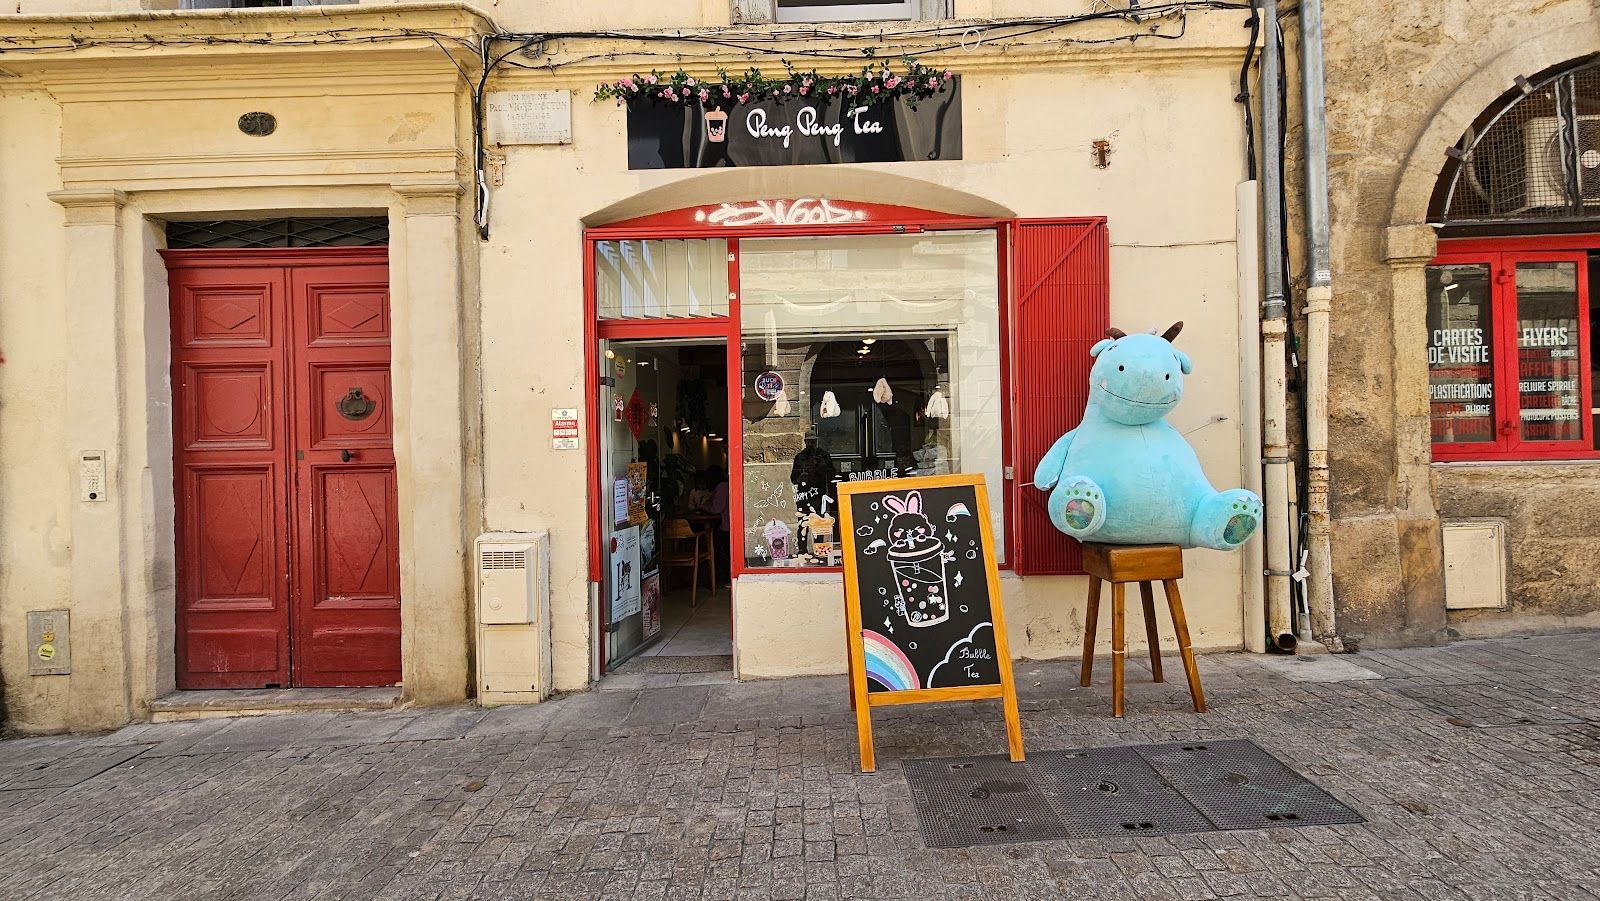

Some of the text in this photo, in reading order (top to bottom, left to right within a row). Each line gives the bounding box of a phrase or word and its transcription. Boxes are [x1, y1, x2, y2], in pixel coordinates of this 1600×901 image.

[746, 105, 883, 149] Peng Peng Tea
[1433, 328, 1483, 346] CARTES
[1522, 327, 1568, 346] FLYERS
[1428, 345, 1489, 364] DE VISITE
[1429, 383, 1492, 400] PLASTIFICATIONS
[1518, 380, 1576, 392] RELIURE SPIRALE
[1465, 404, 1490, 414] PLIAGE
[849, 468, 899, 482] BUBBLE
[959, 646, 992, 660] Bubble
[963, 663, 980, 678] Tea
